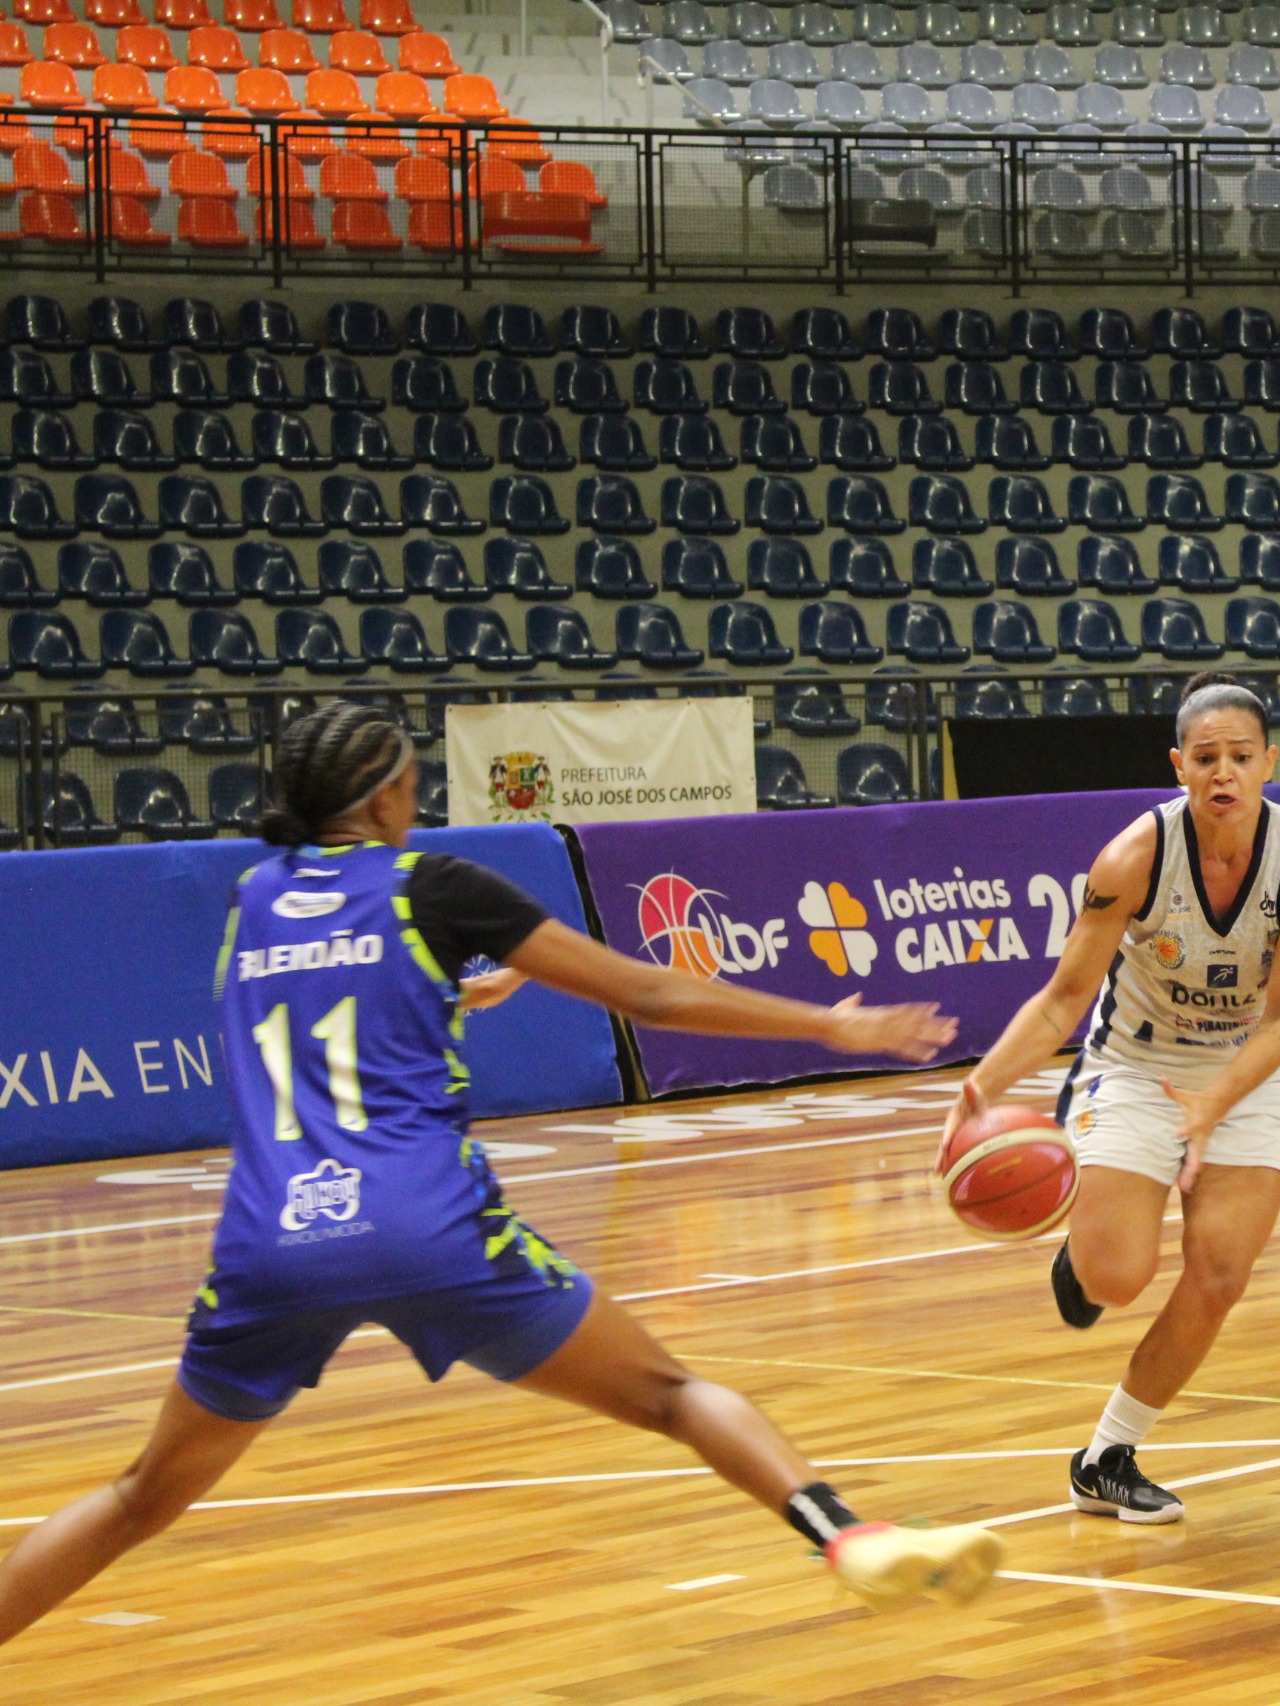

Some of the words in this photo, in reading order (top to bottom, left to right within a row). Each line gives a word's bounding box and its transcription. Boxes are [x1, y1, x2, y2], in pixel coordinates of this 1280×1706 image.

[561, 766, 647, 783] PREFEITURA
[562, 789, 593, 807] SÃO
[597, 787, 633, 806] JOSÉ
[637, 788, 666, 803] DOS
[669, 785, 732, 801] CAMPOS
[873, 866, 1011, 921] loterias
[895, 917, 1030, 974] CAIXA
[134, 1033, 229, 1094] EN
[252, 996, 369, 1141] 11
